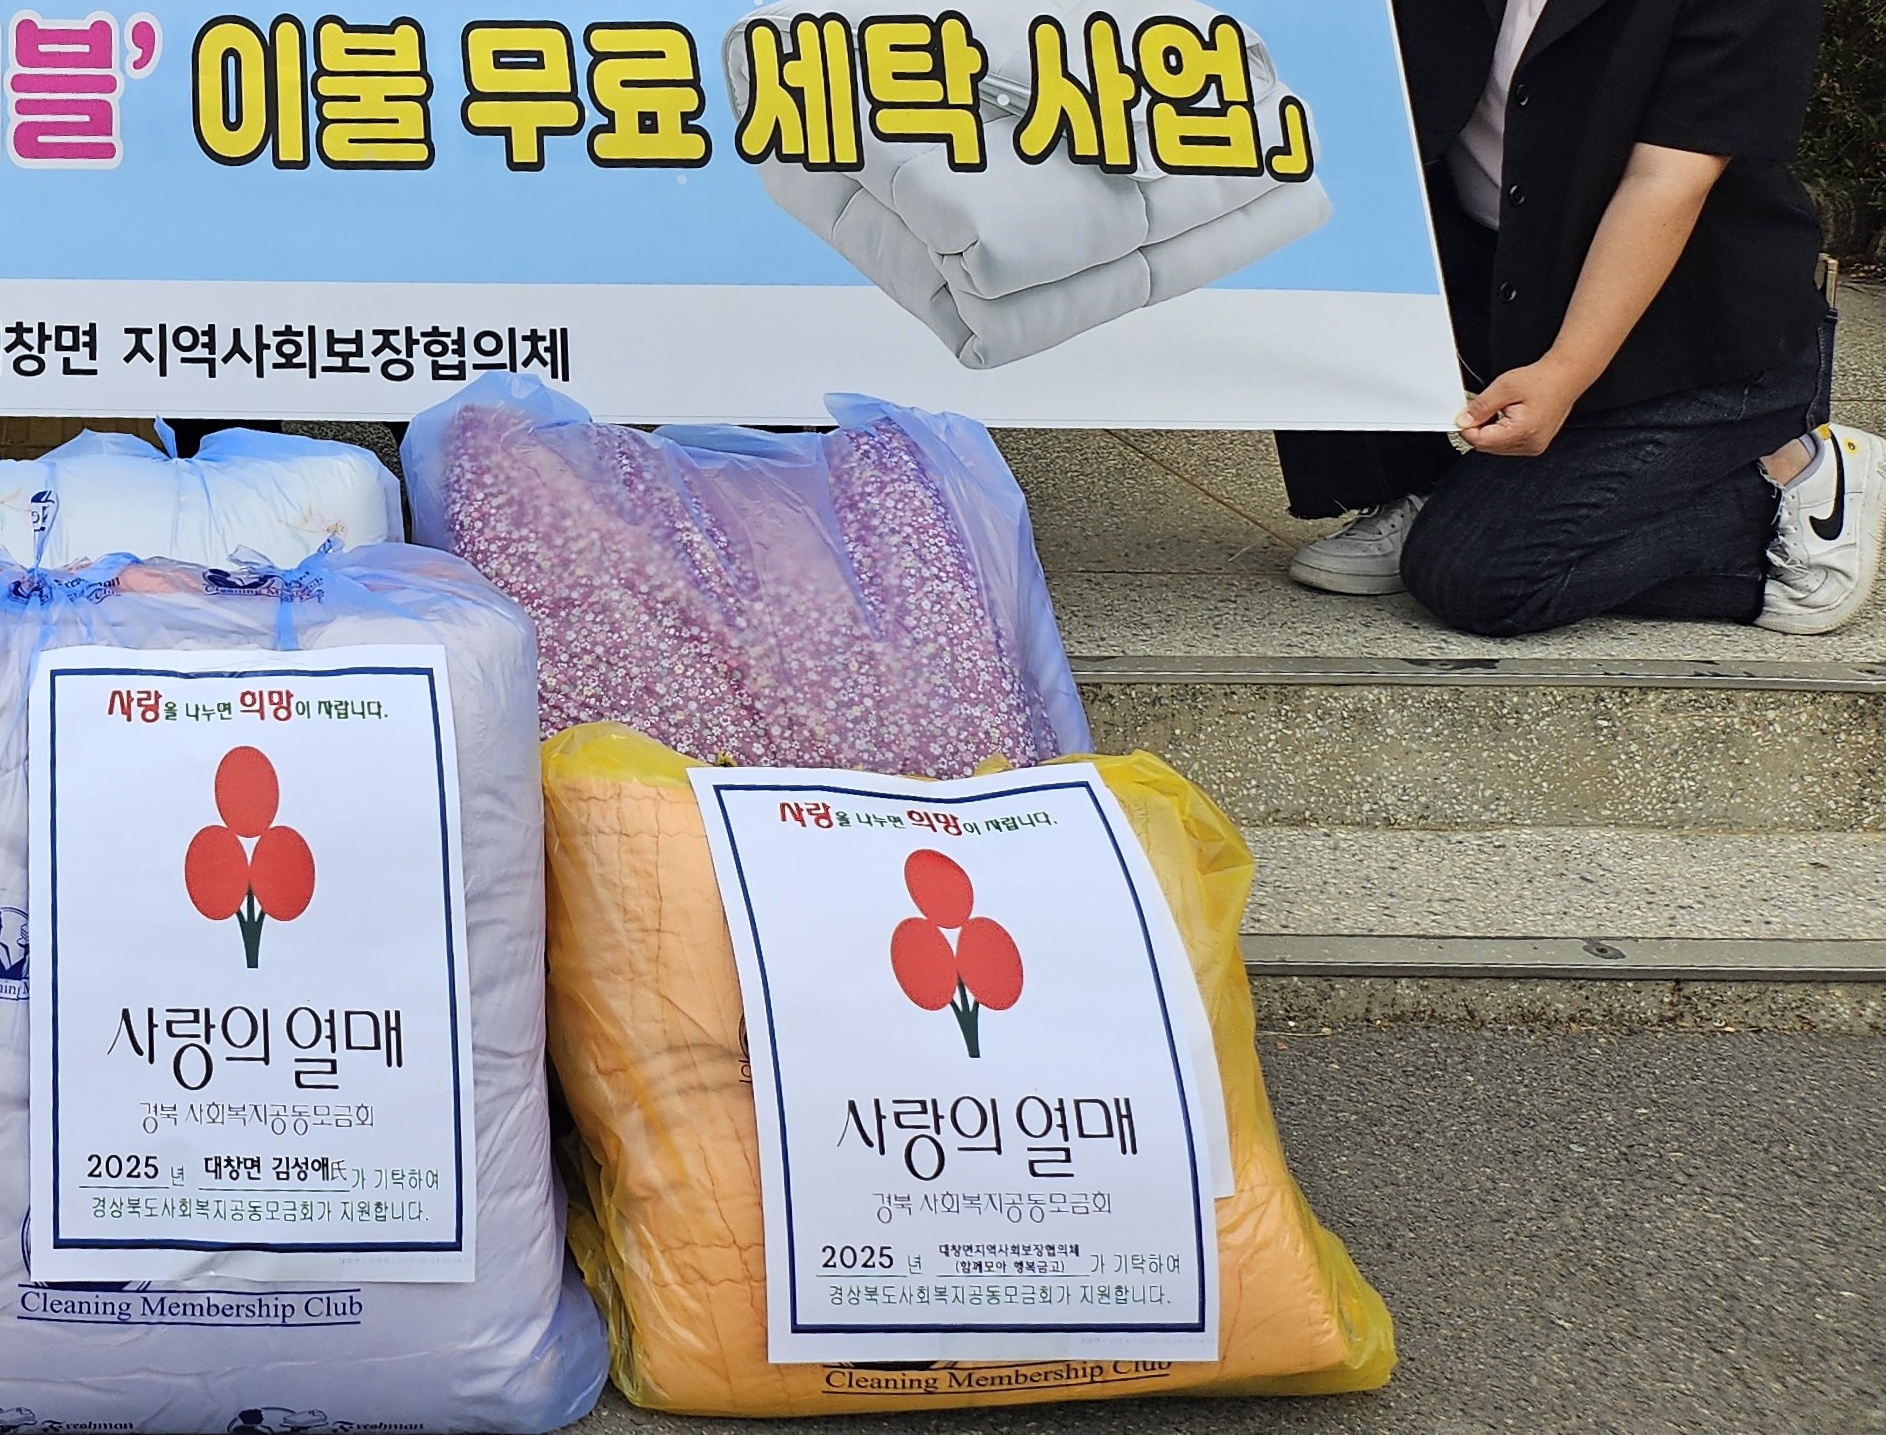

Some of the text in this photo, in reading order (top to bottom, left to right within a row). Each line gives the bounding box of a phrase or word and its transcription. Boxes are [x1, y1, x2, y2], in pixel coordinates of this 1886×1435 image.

[192, 13, 433, 170] 이불
[462, 19, 713, 171] 무료
[736, 10, 988, 172] 세탁
[123, 322, 571, 383] 지역사회보장협의체
[108, 688, 389, 724] 사랑을 나누면 희망이 자랍니다.
[779, 801, 850, 830] 사랑을
[856, 809, 905, 830] 나누면
[908, 807, 982, 837] 희망이
[107, 1005, 405, 1092] 사랑의 열매
[139, 1101, 376, 1137] 경북 사회복지공동모금회
[837, 1095, 1139, 1182] 사랑의 열매
[86, 1154, 161, 1180] 2025
[169, 1164, 185, 1189] 년
[204, 1155, 262, 1181] 대창면
[374, 1166, 440, 1193] 기탁하여
[92, 1195, 430, 1223] 경상북도사회복지공동모금회가 지원합니다.
[872, 1192, 1112, 1225] 경북 사회복지공동모금회
[821, 1242, 1081, 1275] 2025 년 대창면지역사회보장협의체
[1012, 1259, 1066, 1275] 행복금고)
[1114, 1252, 1182, 1277] 기탁하여
[20, 1290, 363, 1324] Cleaning Membership Club
[828, 1283, 1172, 1308] 경상북도사회복지공동모금회가 지원합니다.
[825, 1370, 939, 1393] Cleaning
[947, 1361, 1104, 1390] Membership
